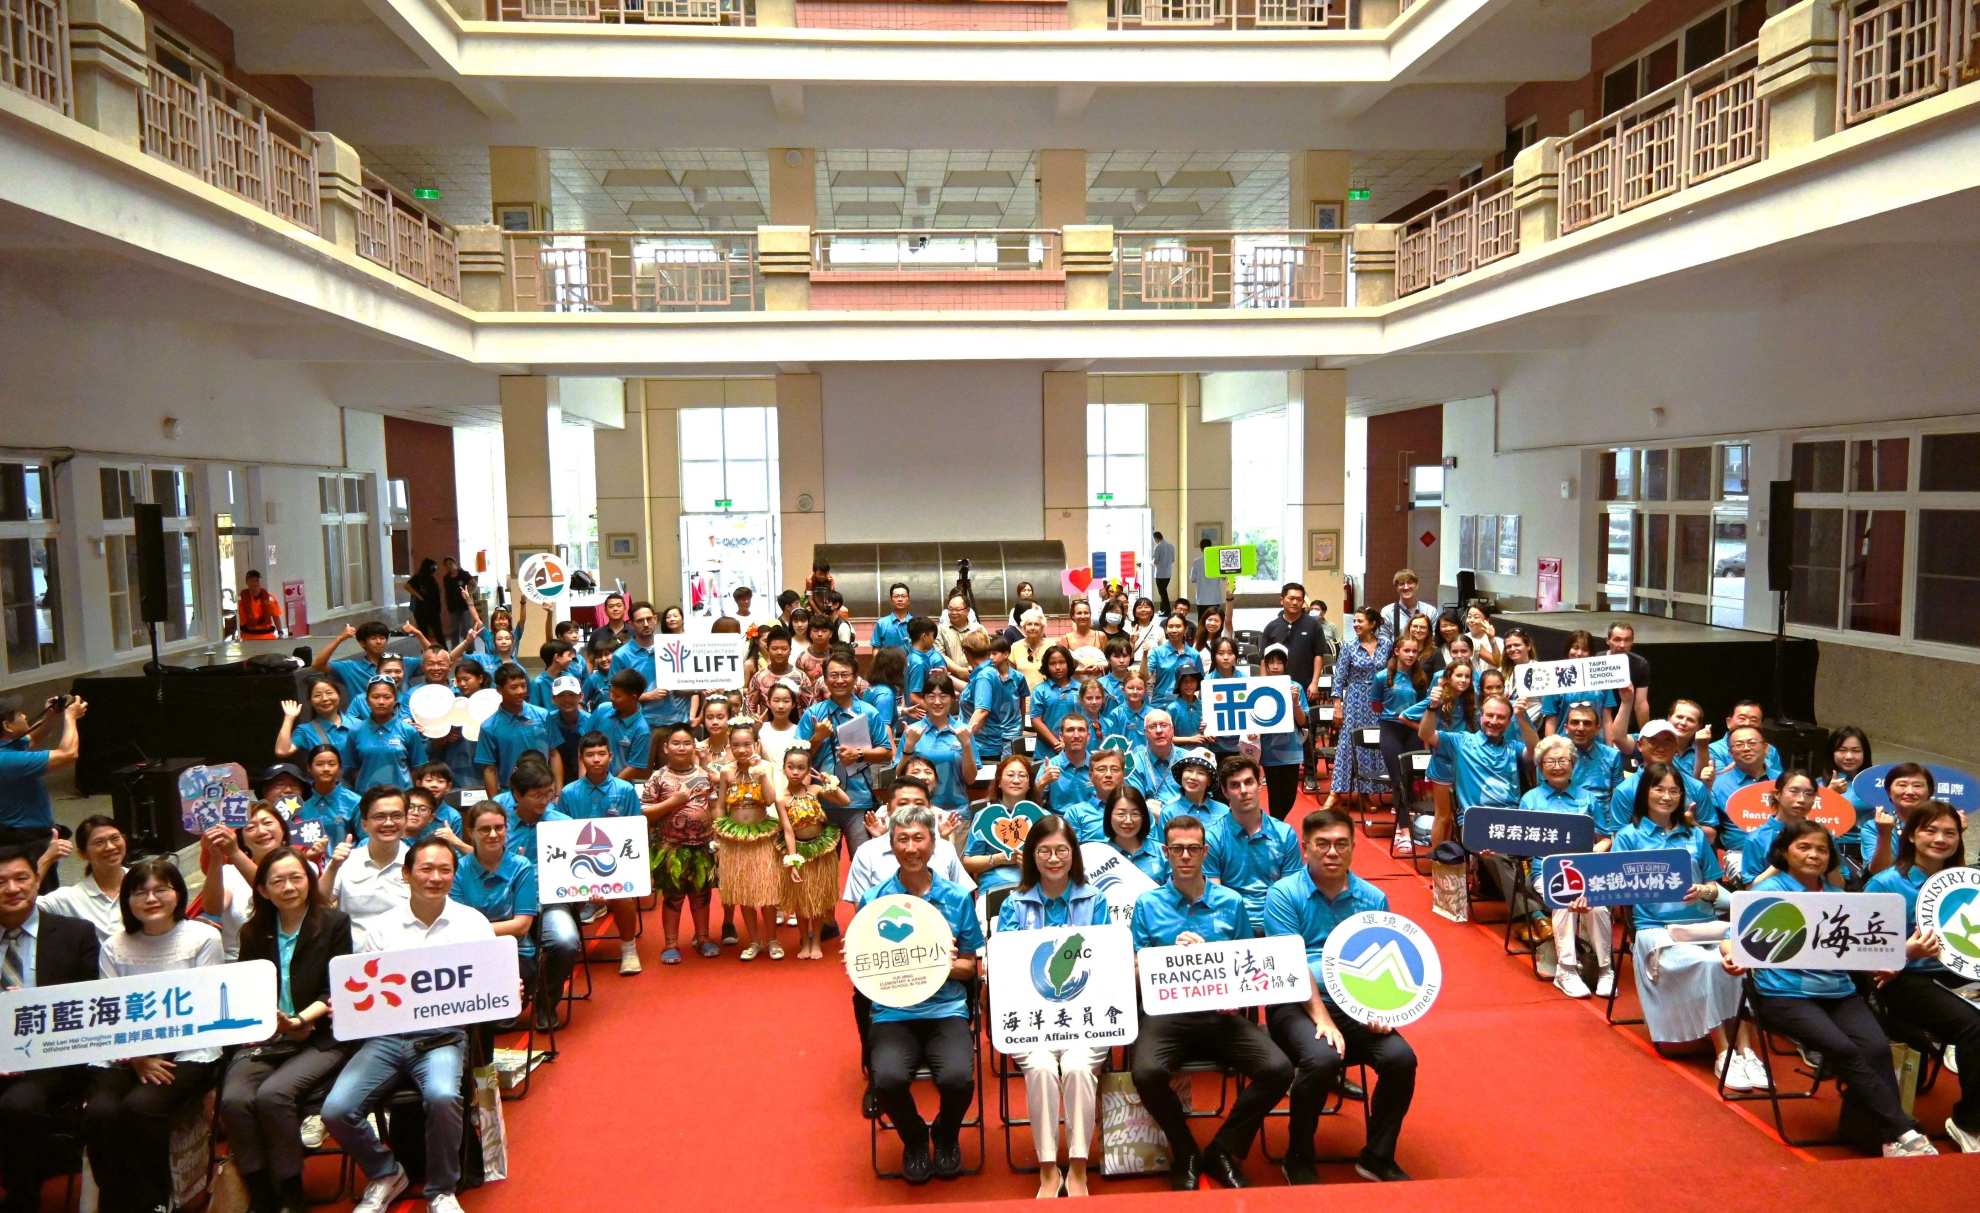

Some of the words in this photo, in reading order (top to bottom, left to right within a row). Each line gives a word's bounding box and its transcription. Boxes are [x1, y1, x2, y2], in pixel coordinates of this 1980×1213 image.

[693, 655, 739, 673] LIFT
[1589, 665, 1621, 673] EUROPEAN
[1937, 782, 1965, 796] 國際
[619, 838, 641, 859] 尾
[1089, 856, 1120, 880] NAMR
[556, 882, 634, 897] Shanwei
[1921, 870, 1966, 927] MINISTRY
[1811, 904, 1899, 959] 海岳
[853, 943, 947, 972] 岳明國中小
[1063, 948, 1093, 960] OAC
[1165, 951, 1224, 968] BUREAU
[1150, 966, 1227, 985] FRANÇAIS
[1158, 987, 1178, 1001] DE
[1182, 983, 1229, 999] TAIPEI
[1324, 956, 1349, 1005] Ministry
[1349, 1005, 1364, 1016] of
[1366, 983, 1437, 1024] Environment
[13, 986, 194, 1037] 蔚藍海彰化
[412, 993, 510, 1019] renewables
[1002, 1005, 1124, 1032] 海洋委員會
[1004, 1035, 1039, 1044] Ocean
[1044, 1032, 1080, 1042] Affairs
[1084, 1027, 1126, 1039] Council
